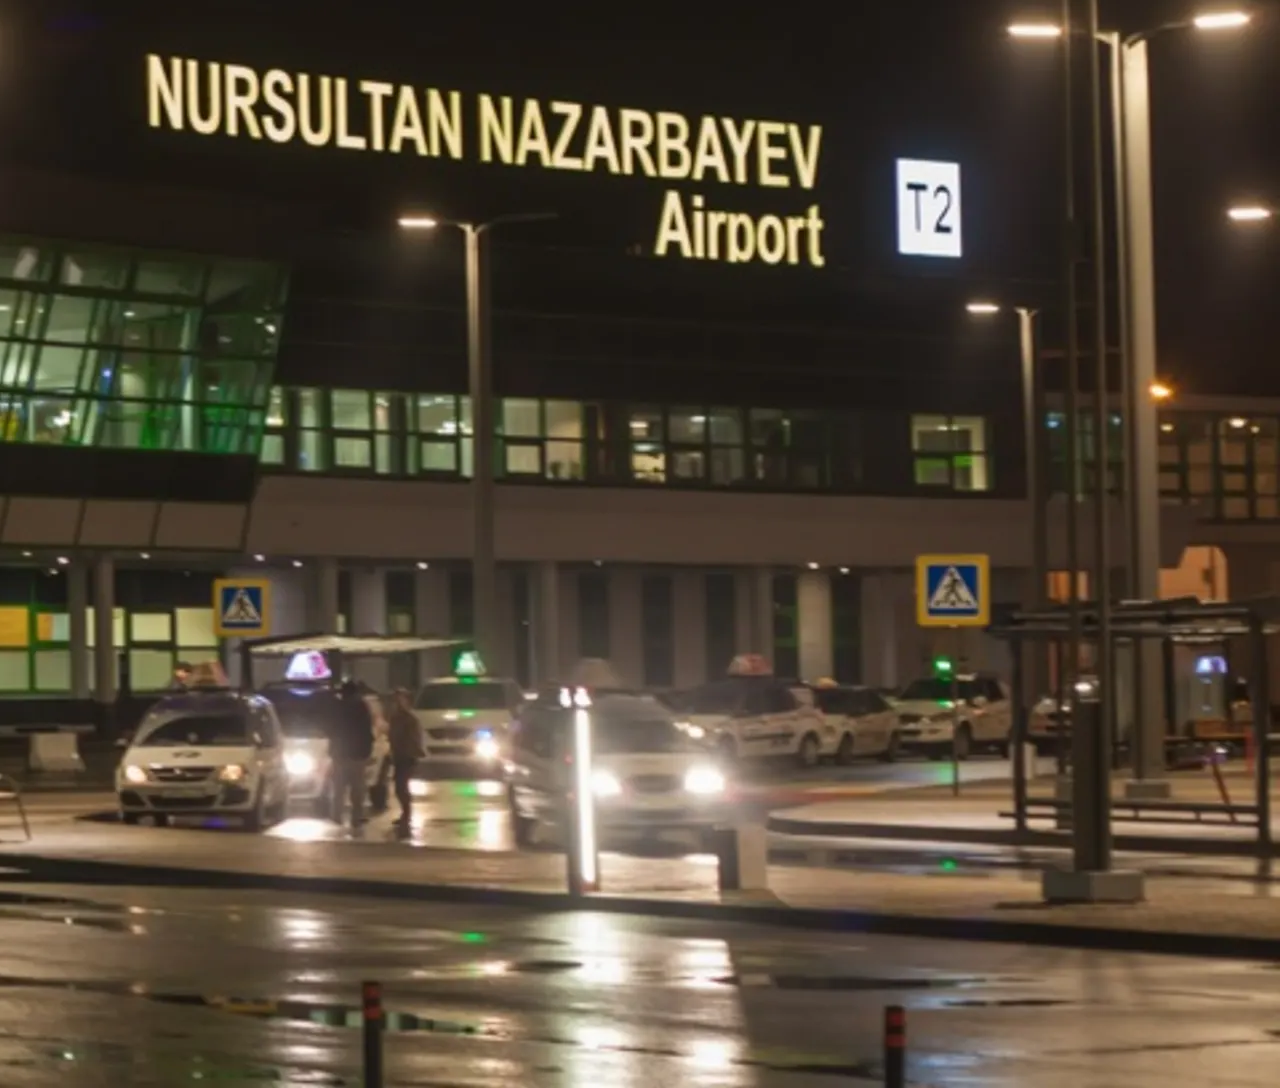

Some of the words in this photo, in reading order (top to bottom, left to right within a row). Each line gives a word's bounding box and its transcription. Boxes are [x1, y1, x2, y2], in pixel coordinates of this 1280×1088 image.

[146, 53, 463, 161] NURSULTAN
[478, 92, 823, 190] NAZARBAYEV
[653, 188, 826, 268] Airport
[906, 181, 953, 234] T2
